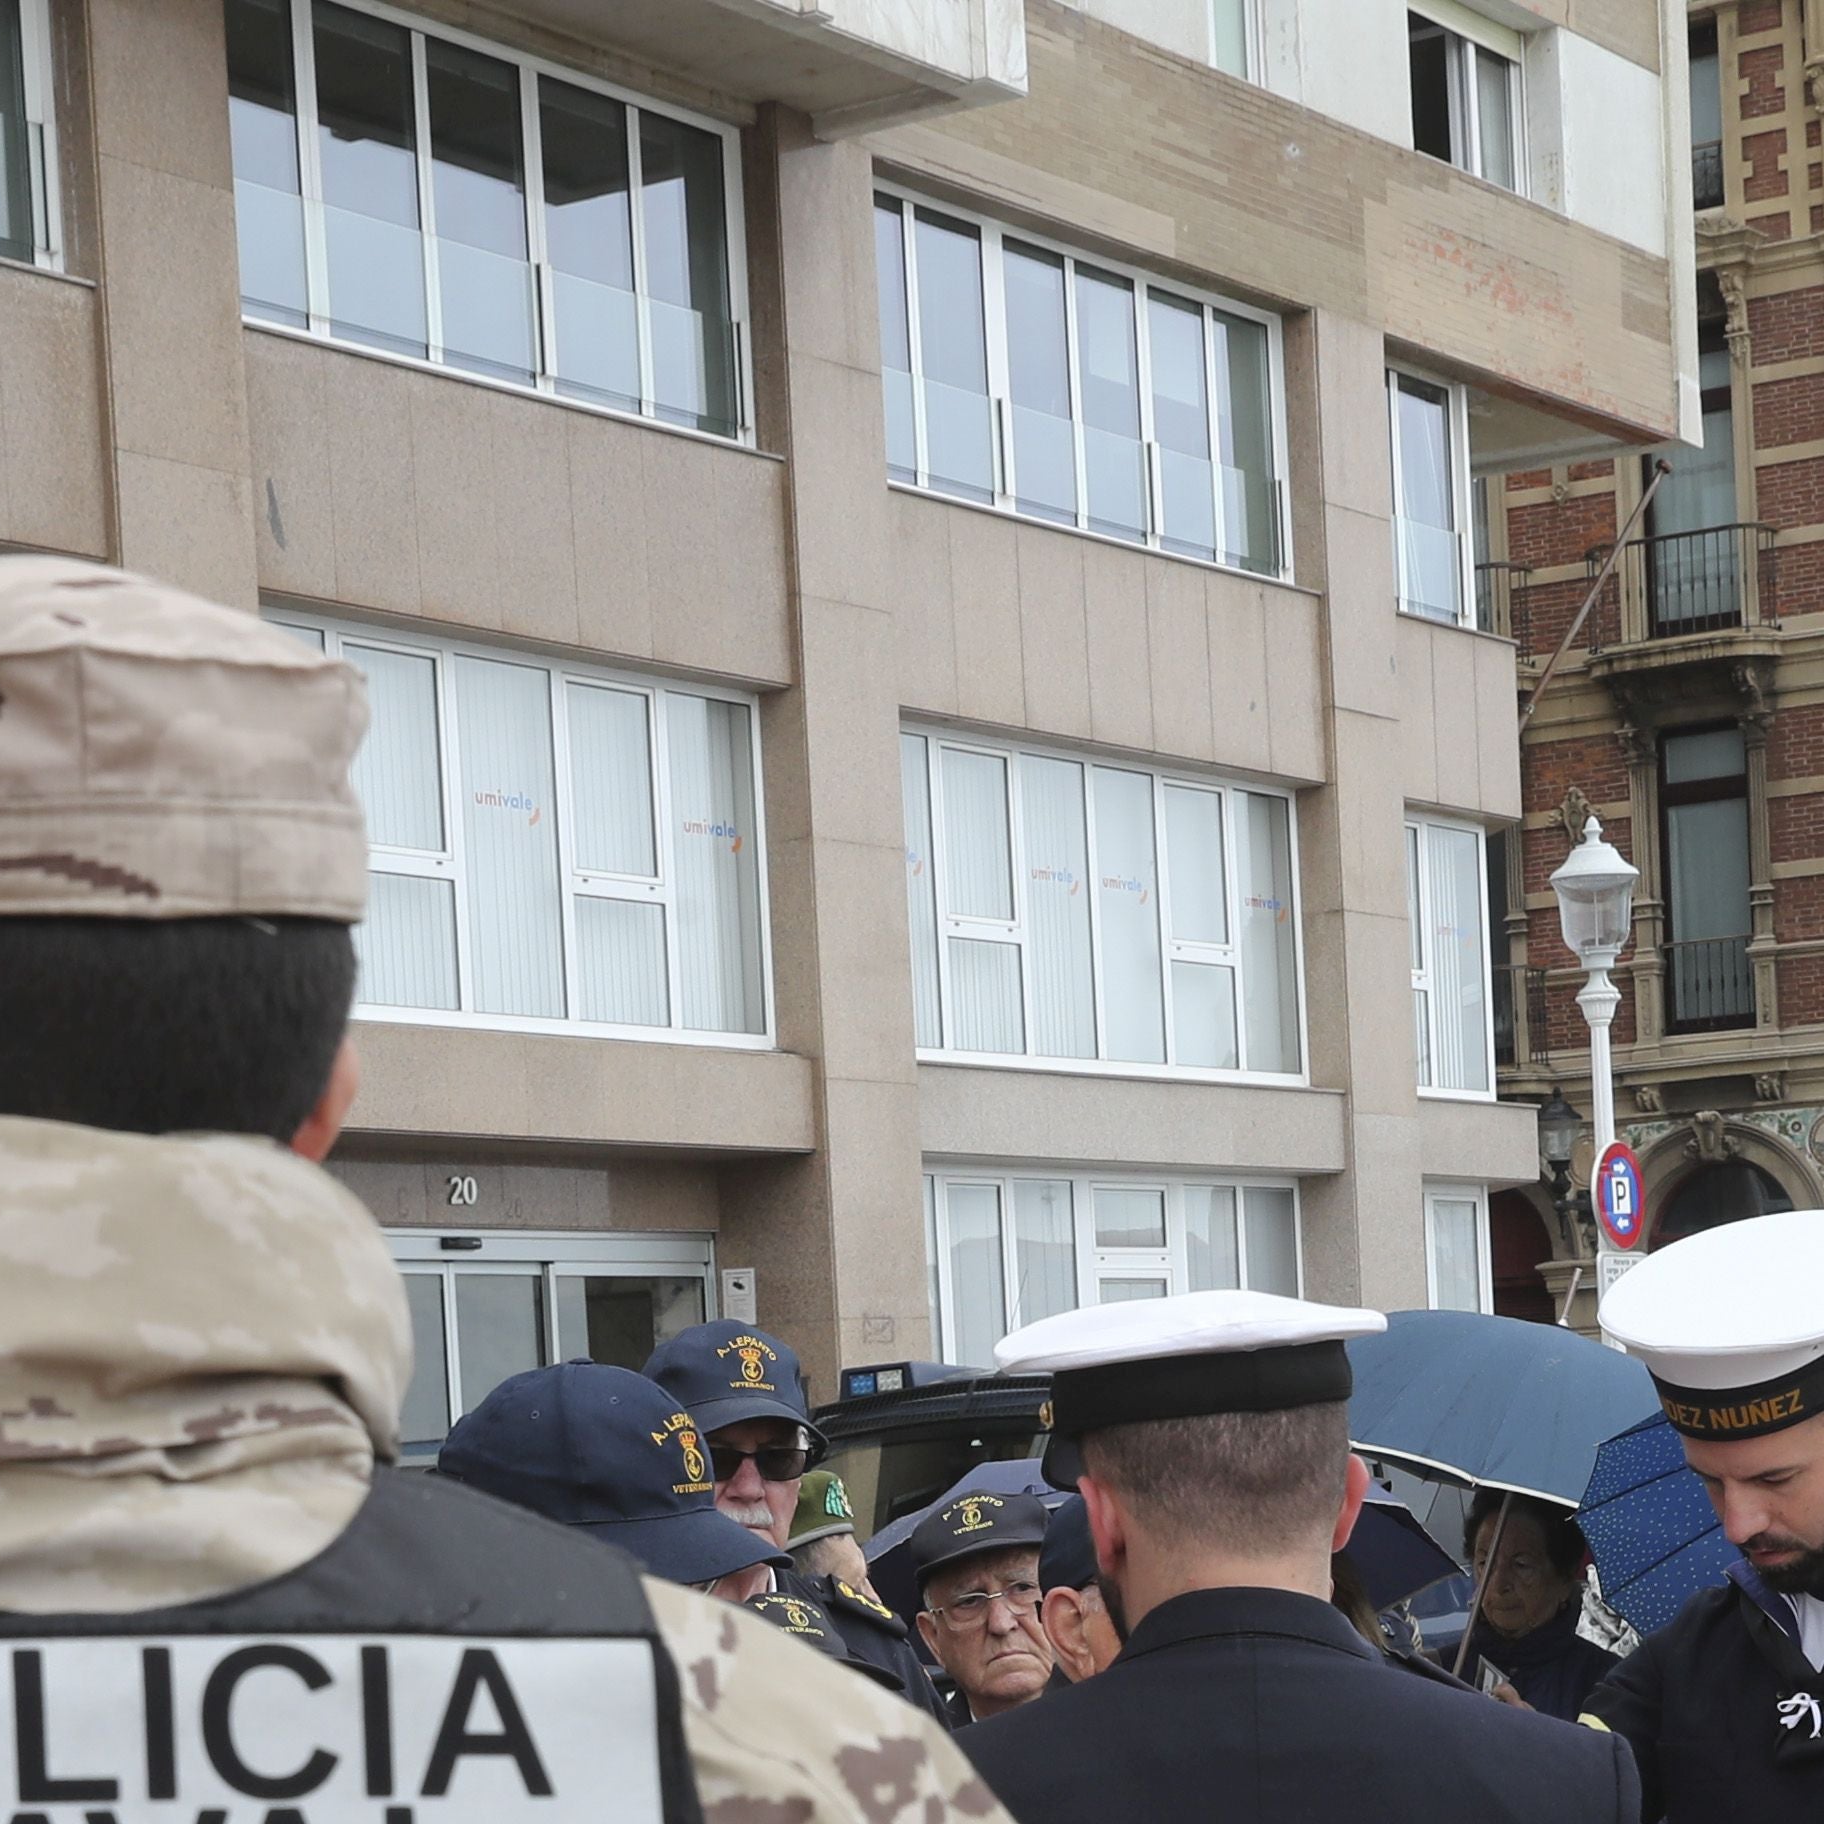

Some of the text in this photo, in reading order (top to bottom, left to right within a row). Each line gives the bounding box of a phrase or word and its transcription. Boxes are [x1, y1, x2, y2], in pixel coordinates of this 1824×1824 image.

[475, 789, 532, 810] umivale
[683, 818, 735, 838] umivale
[450, 1175, 478, 1206] 20
[1615, 1180, 1626, 1211] P
[727, 1335, 777, 1361] LEPANTO
[729, 1380, 775, 1391] VETERANOS
[1708, 1387, 1805, 1430] NUÑEZ
[952, 1495, 1004, 1510] LEPANTO
